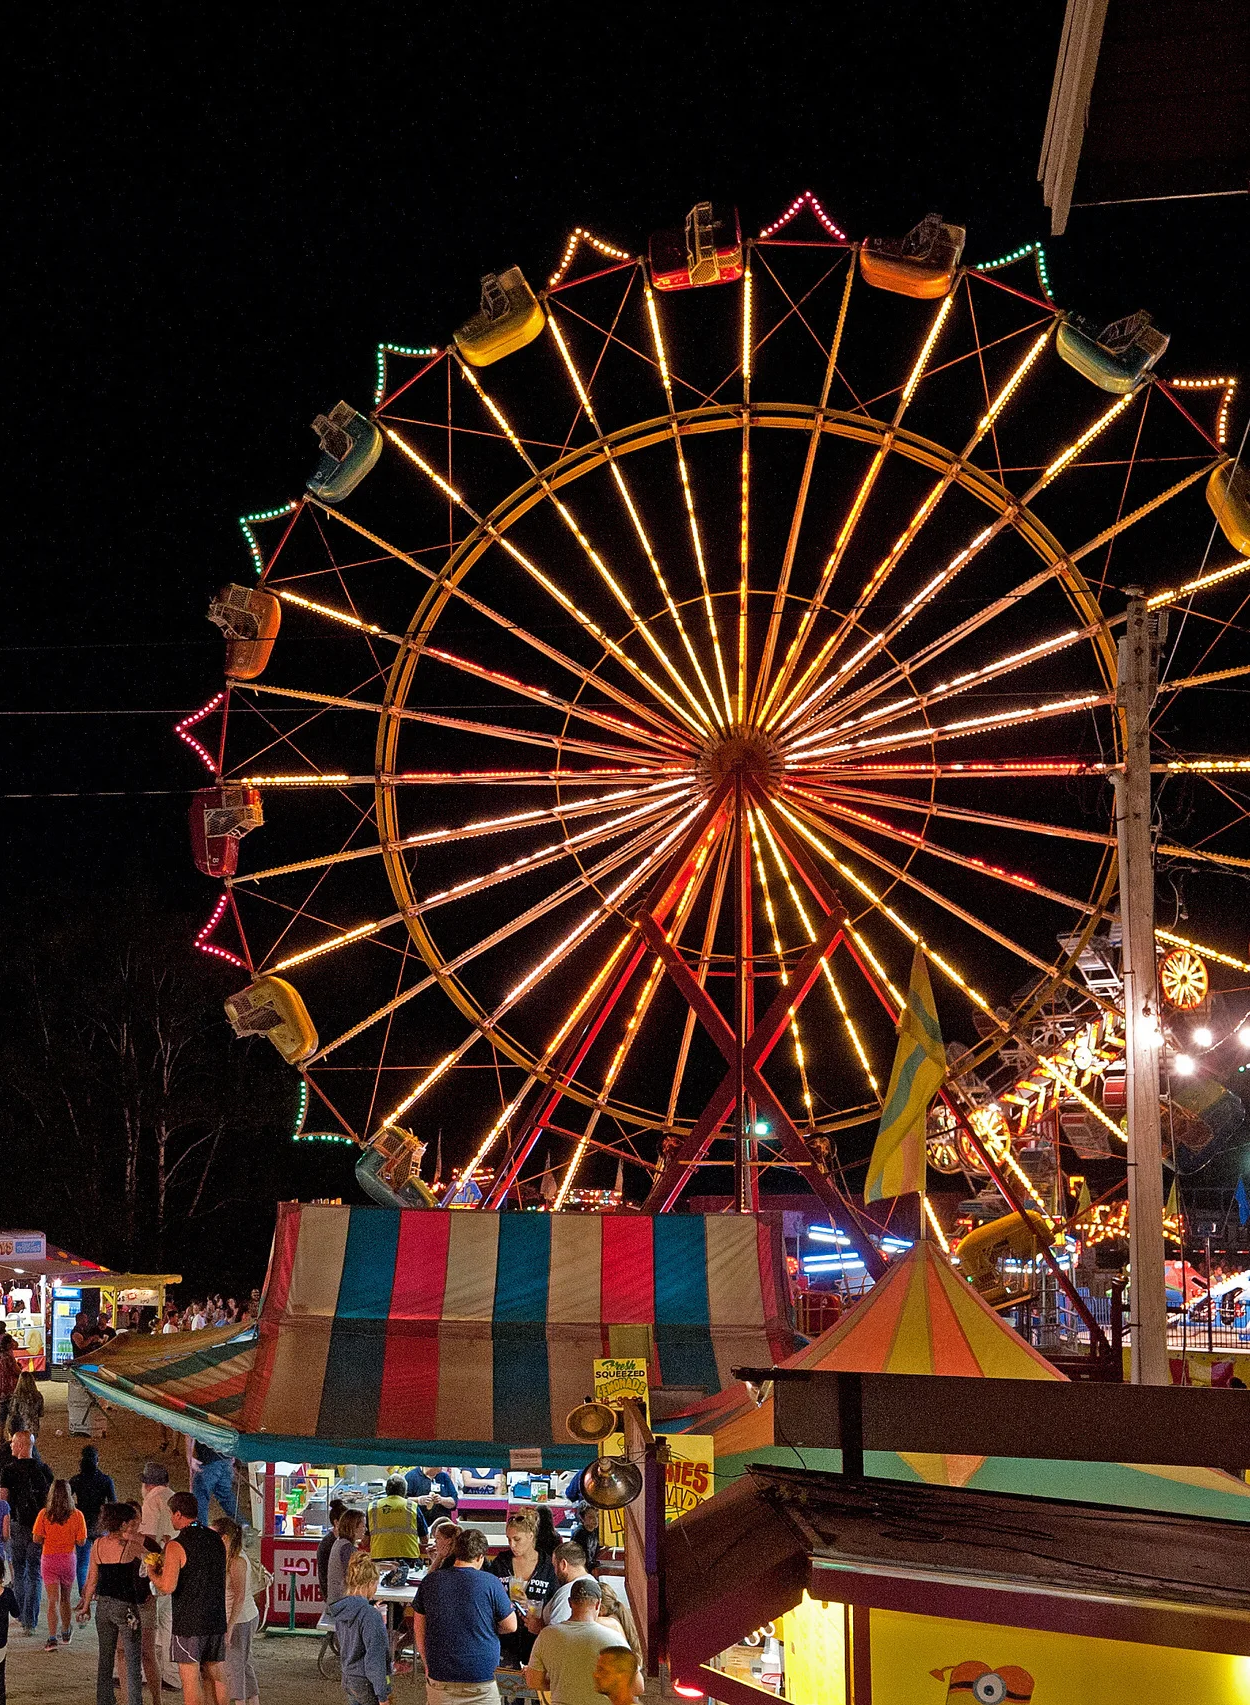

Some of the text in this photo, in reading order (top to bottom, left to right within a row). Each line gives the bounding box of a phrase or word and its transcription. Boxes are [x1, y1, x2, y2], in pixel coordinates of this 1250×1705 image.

[595, 1370, 645, 1379] SQUEEZED
[595, 1377, 647, 1399] LEMONADE
[283, 1558, 317, 1577] HOT
[277, 1583, 323, 1602] HAMB
